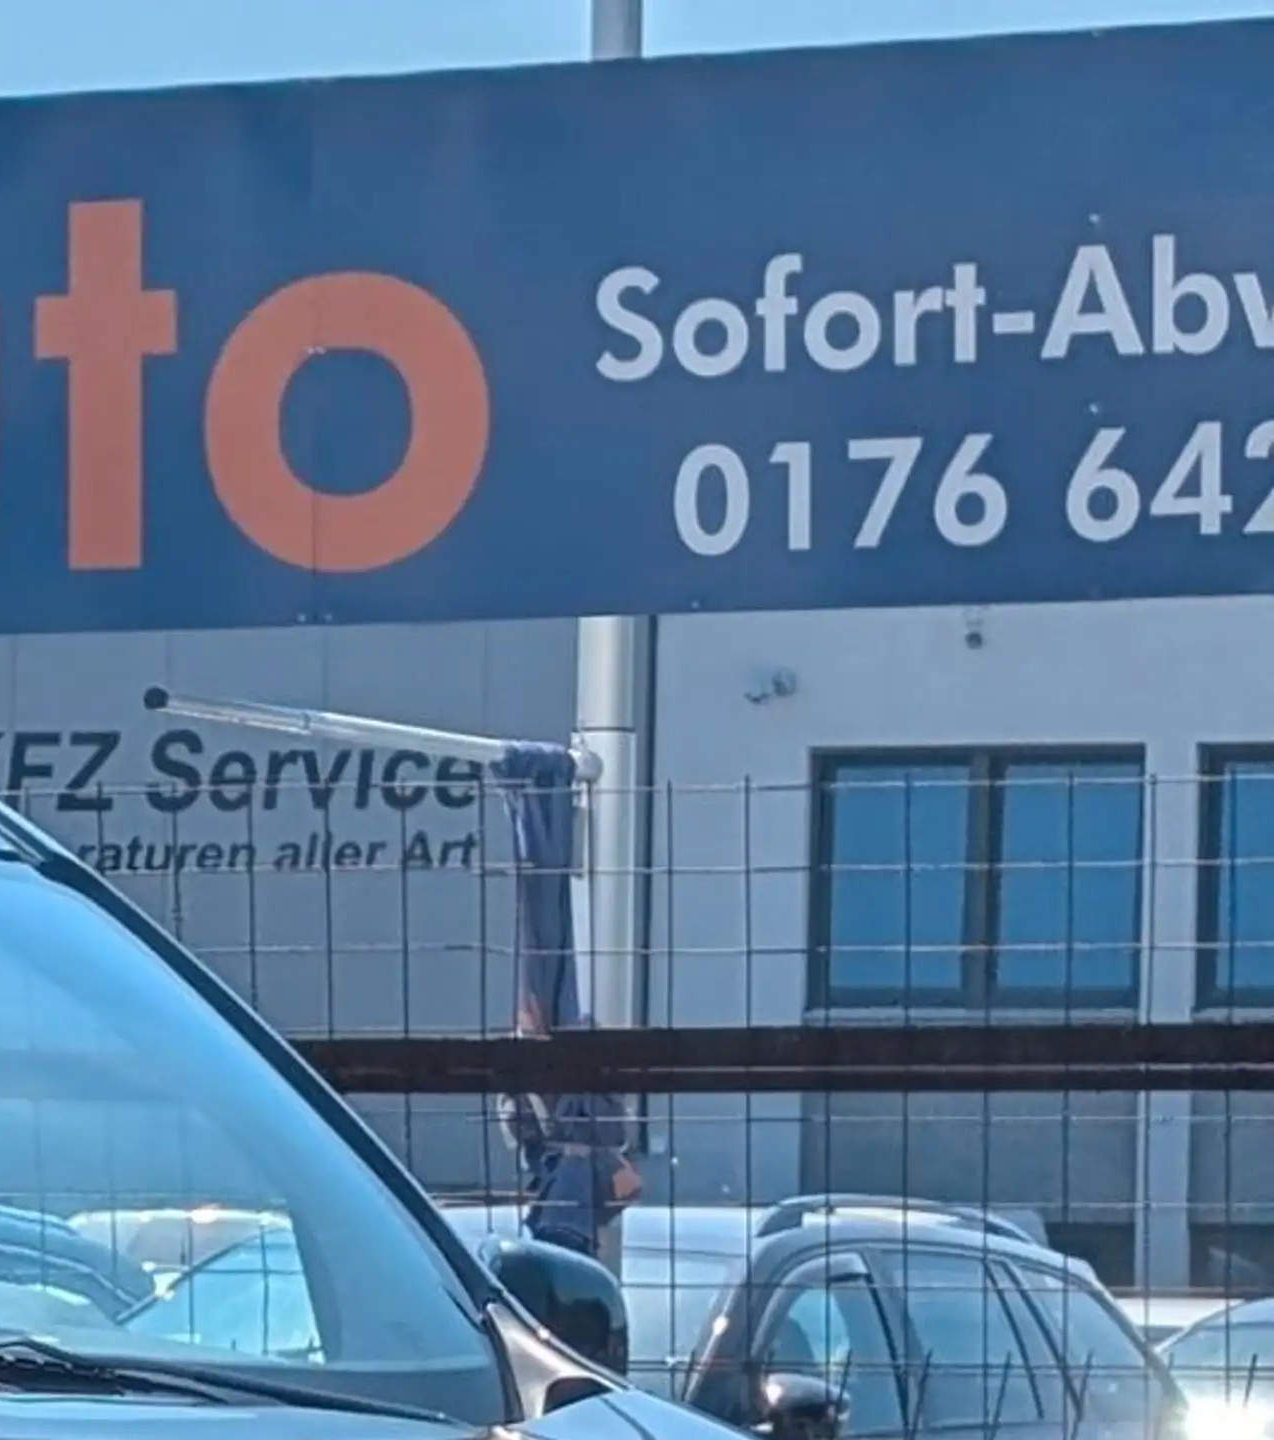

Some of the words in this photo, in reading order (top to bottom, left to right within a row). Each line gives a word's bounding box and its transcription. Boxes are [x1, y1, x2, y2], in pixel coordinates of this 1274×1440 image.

[673, 434, 1008, 556] 0176
[147, 729, 482, 813] Service
[273, 831, 388, 872] aller
[401, 829, 478, 870] Art
